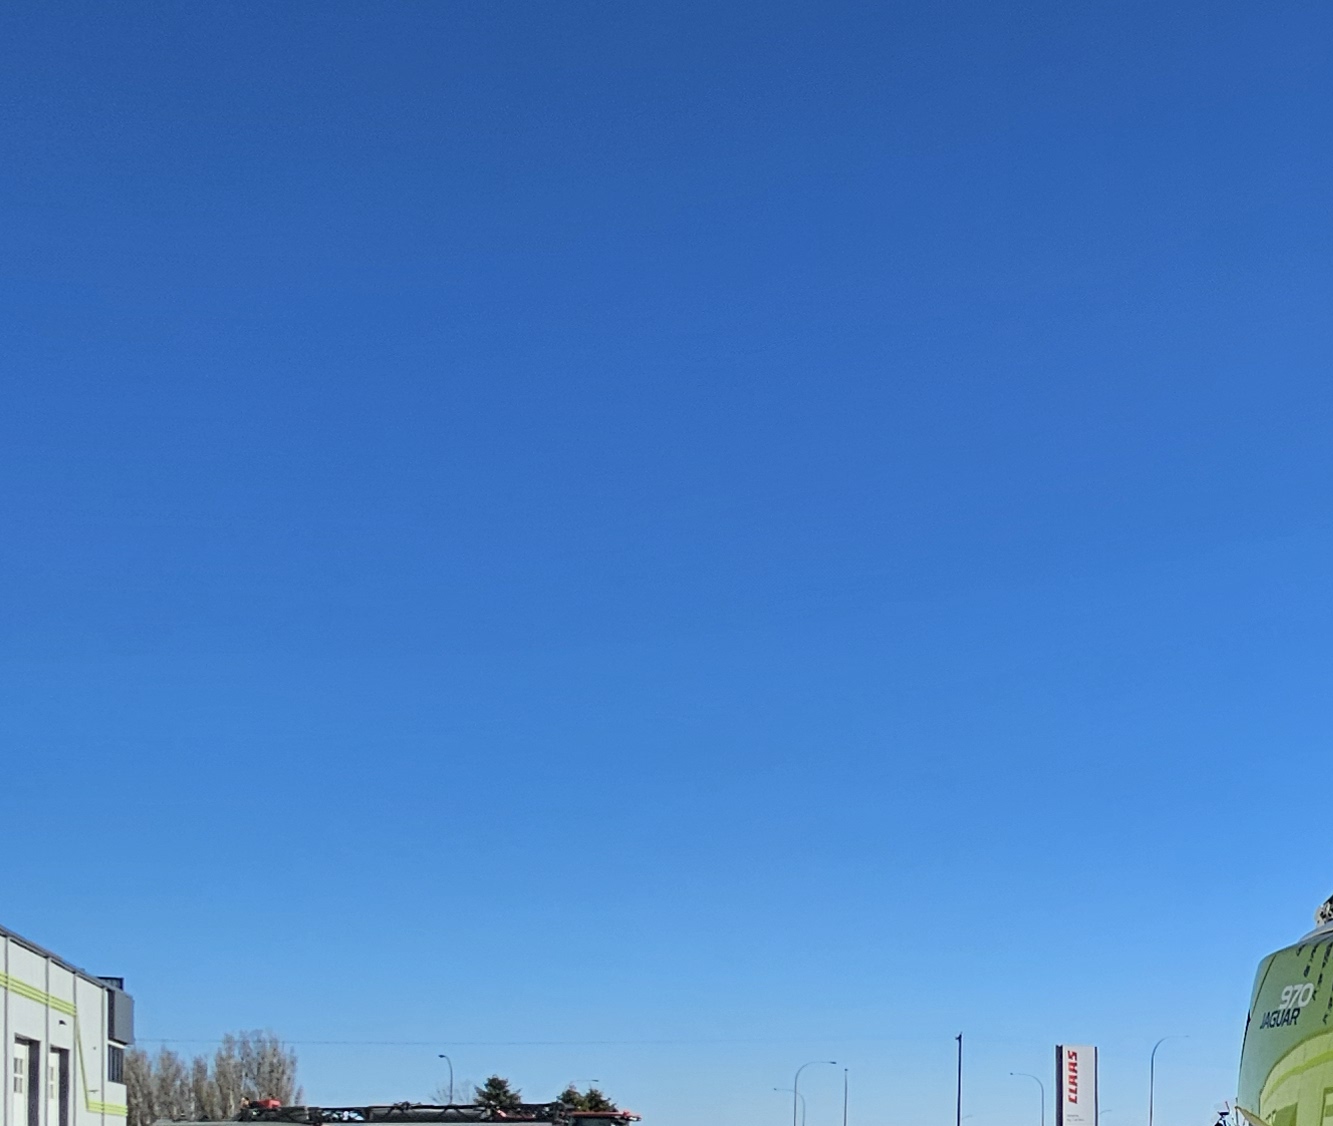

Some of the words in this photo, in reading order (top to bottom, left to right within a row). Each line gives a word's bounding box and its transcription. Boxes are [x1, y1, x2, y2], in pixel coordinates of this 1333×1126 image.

[1279, 983, 1314, 1009] 970
[1259, 1007, 1301, 1030] JAGUAR
[1067, 1050, 1079, 1105] CLAAS
